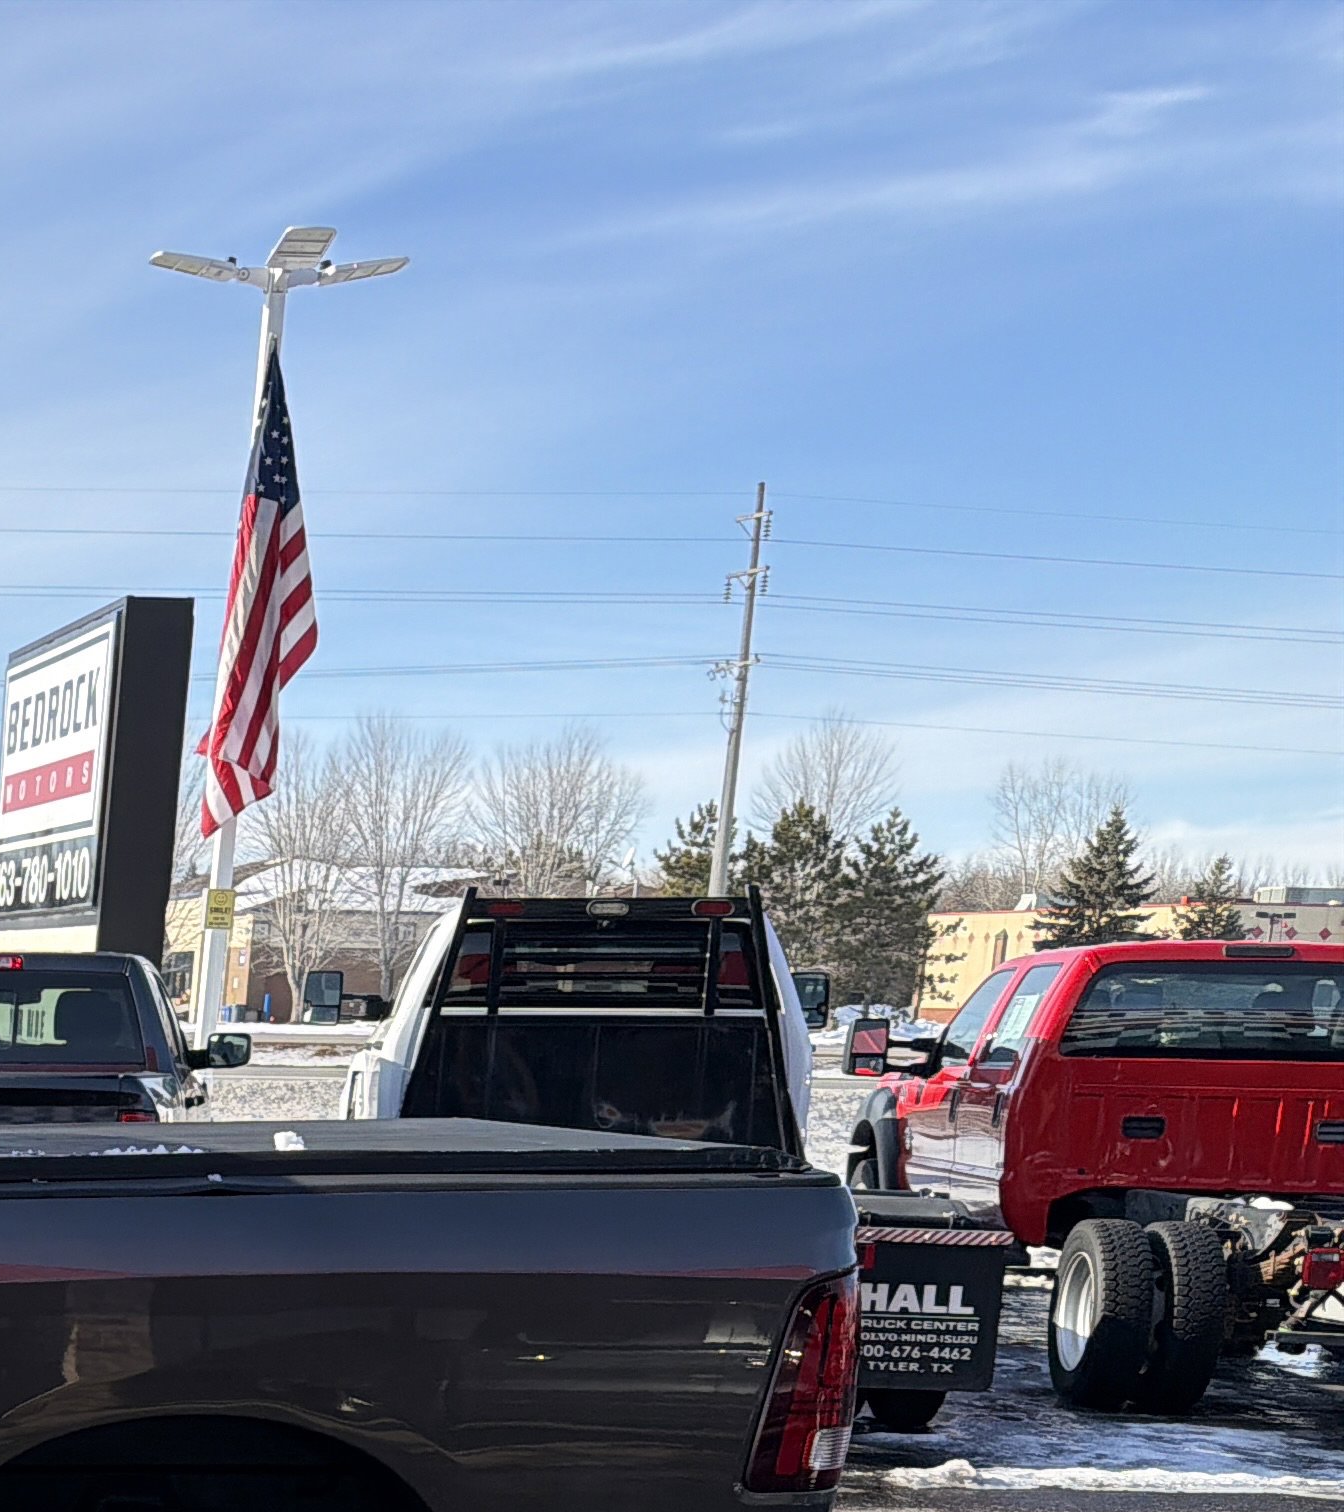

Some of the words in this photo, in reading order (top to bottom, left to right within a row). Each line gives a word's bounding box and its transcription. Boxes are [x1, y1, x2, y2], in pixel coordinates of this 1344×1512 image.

[7, 667, 100, 756] BEDROCK
[6, 761, 90, 804] MOTORS
[860, 1319, 907, 1329] RUCK
[910, 1321, 980, 1331] CENTER
[931, 1363, 954, 1373] TX
